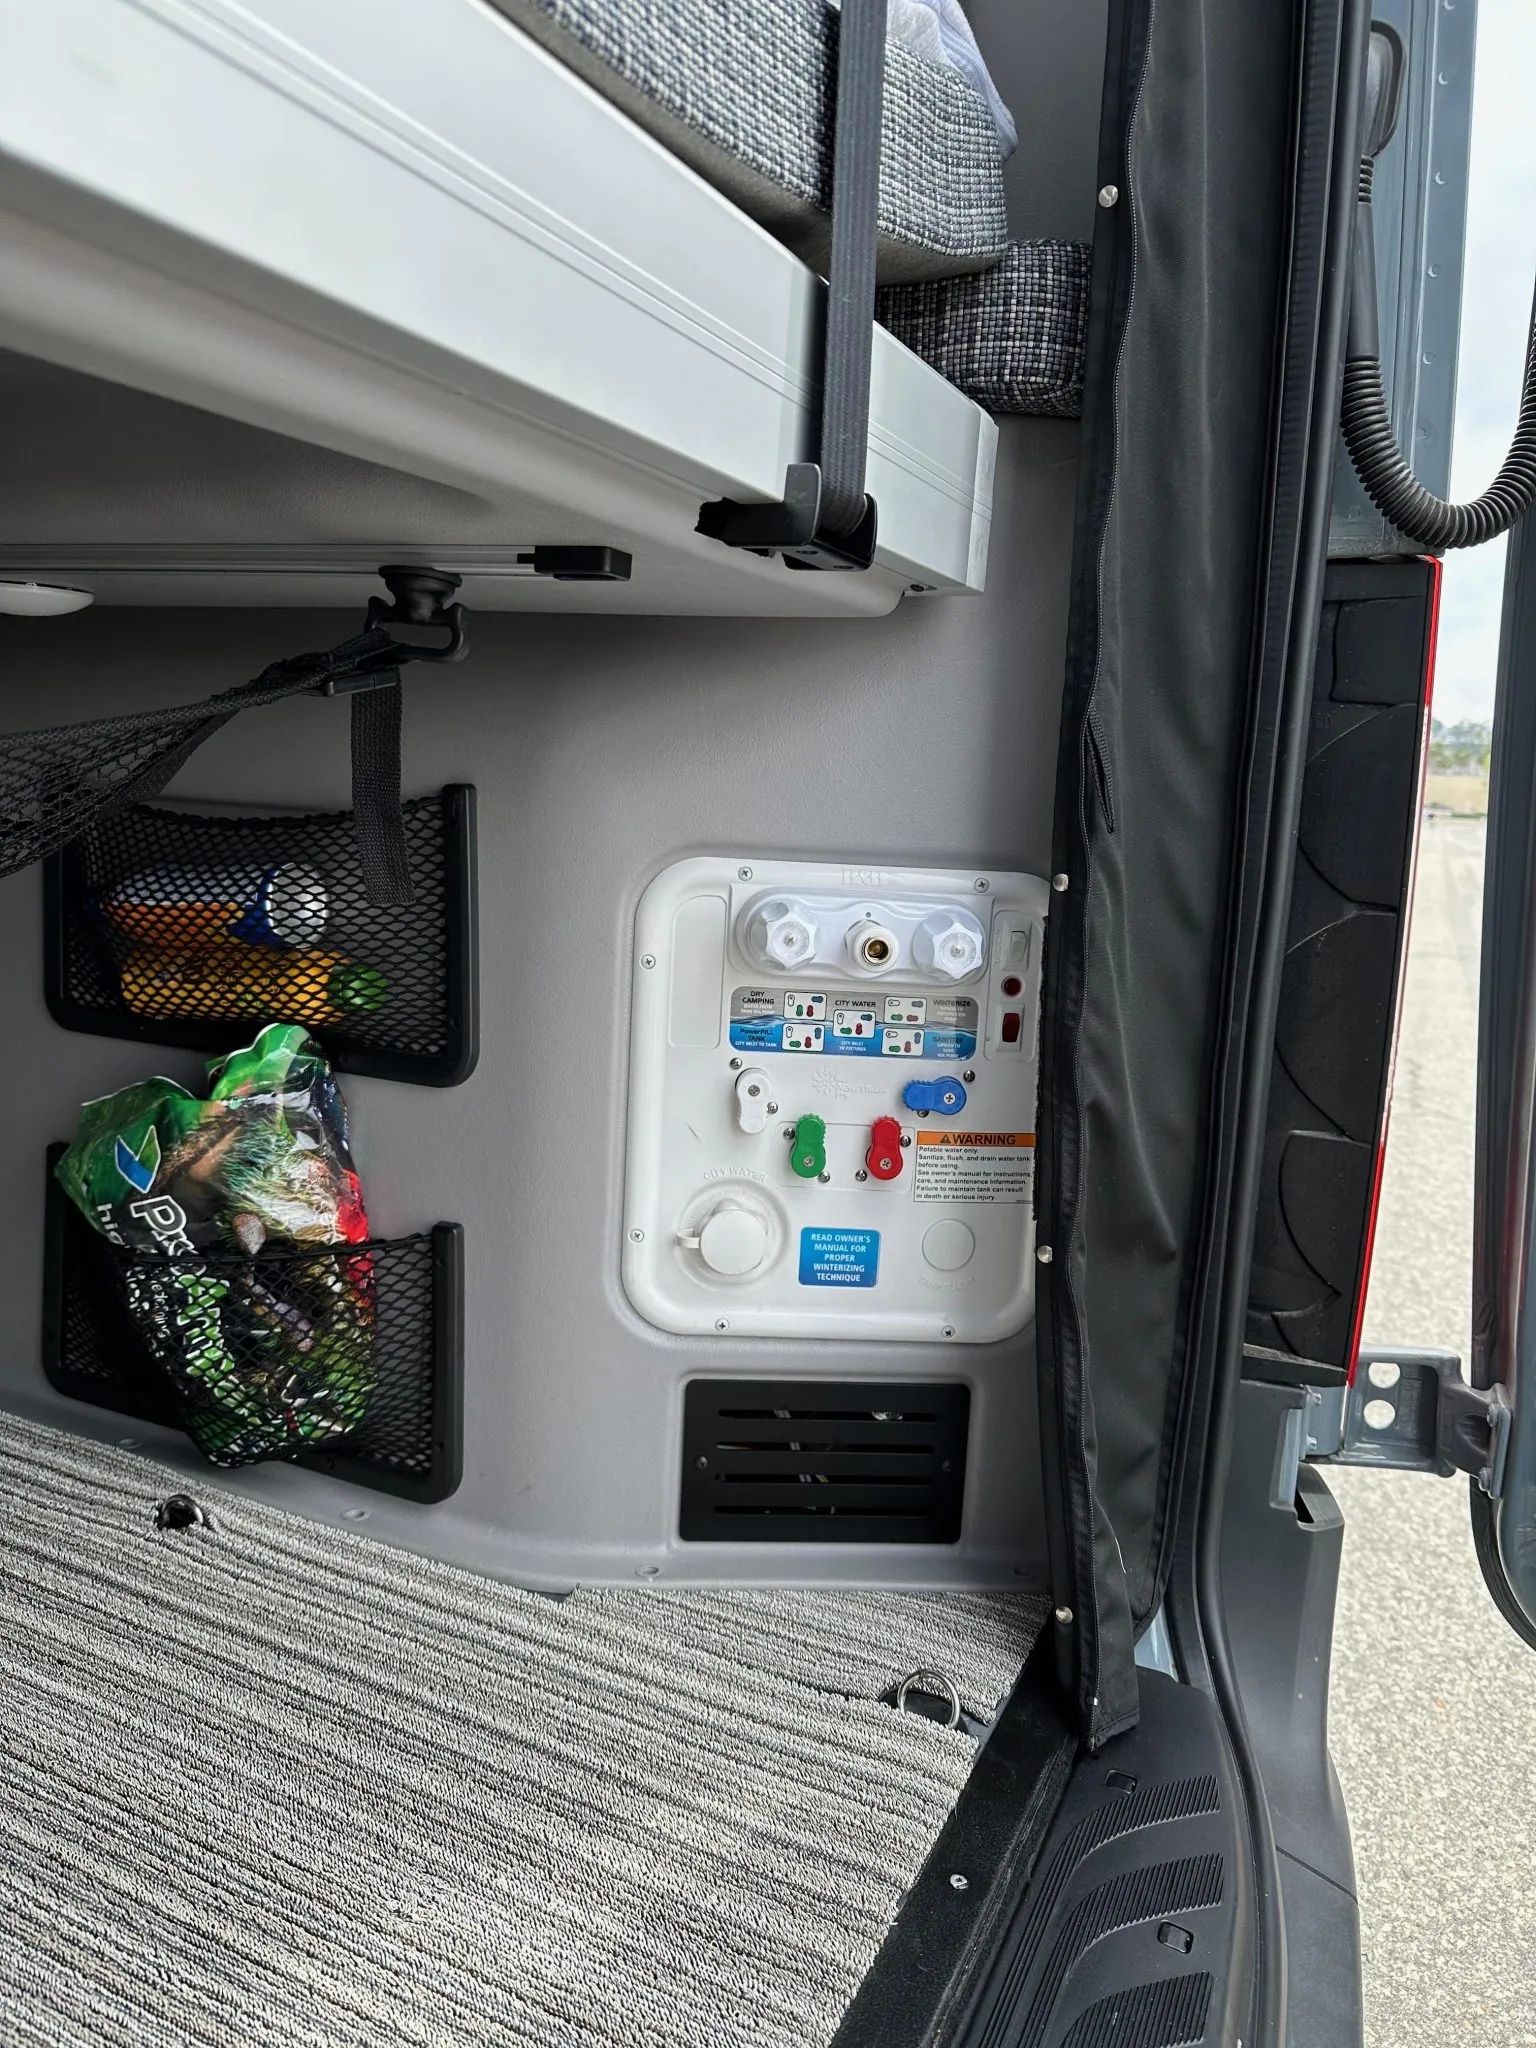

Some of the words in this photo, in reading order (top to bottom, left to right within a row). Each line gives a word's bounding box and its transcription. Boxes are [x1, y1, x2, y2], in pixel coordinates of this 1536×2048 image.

[742, 997, 775, 1005] CAMPING
[852, 1000, 877, 1008] WATER
[952, 1134, 1016, 1145] WARNING
[703, 1167, 726, 1181] CITY
[729, 1166, 767, 1183] WATER
[811, 1233, 833, 1242] READ
[834, 1234, 871, 1243] OWNER'S
[814, 1243, 849, 1252] MANUAL
[850, 1245, 866, 1253] FOR
[824, 1253, 855, 1262] PROPER
[813, 1263, 865, 1272] WINTERIZING
[816, 1272, 861, 1282] TECHNIQUE
